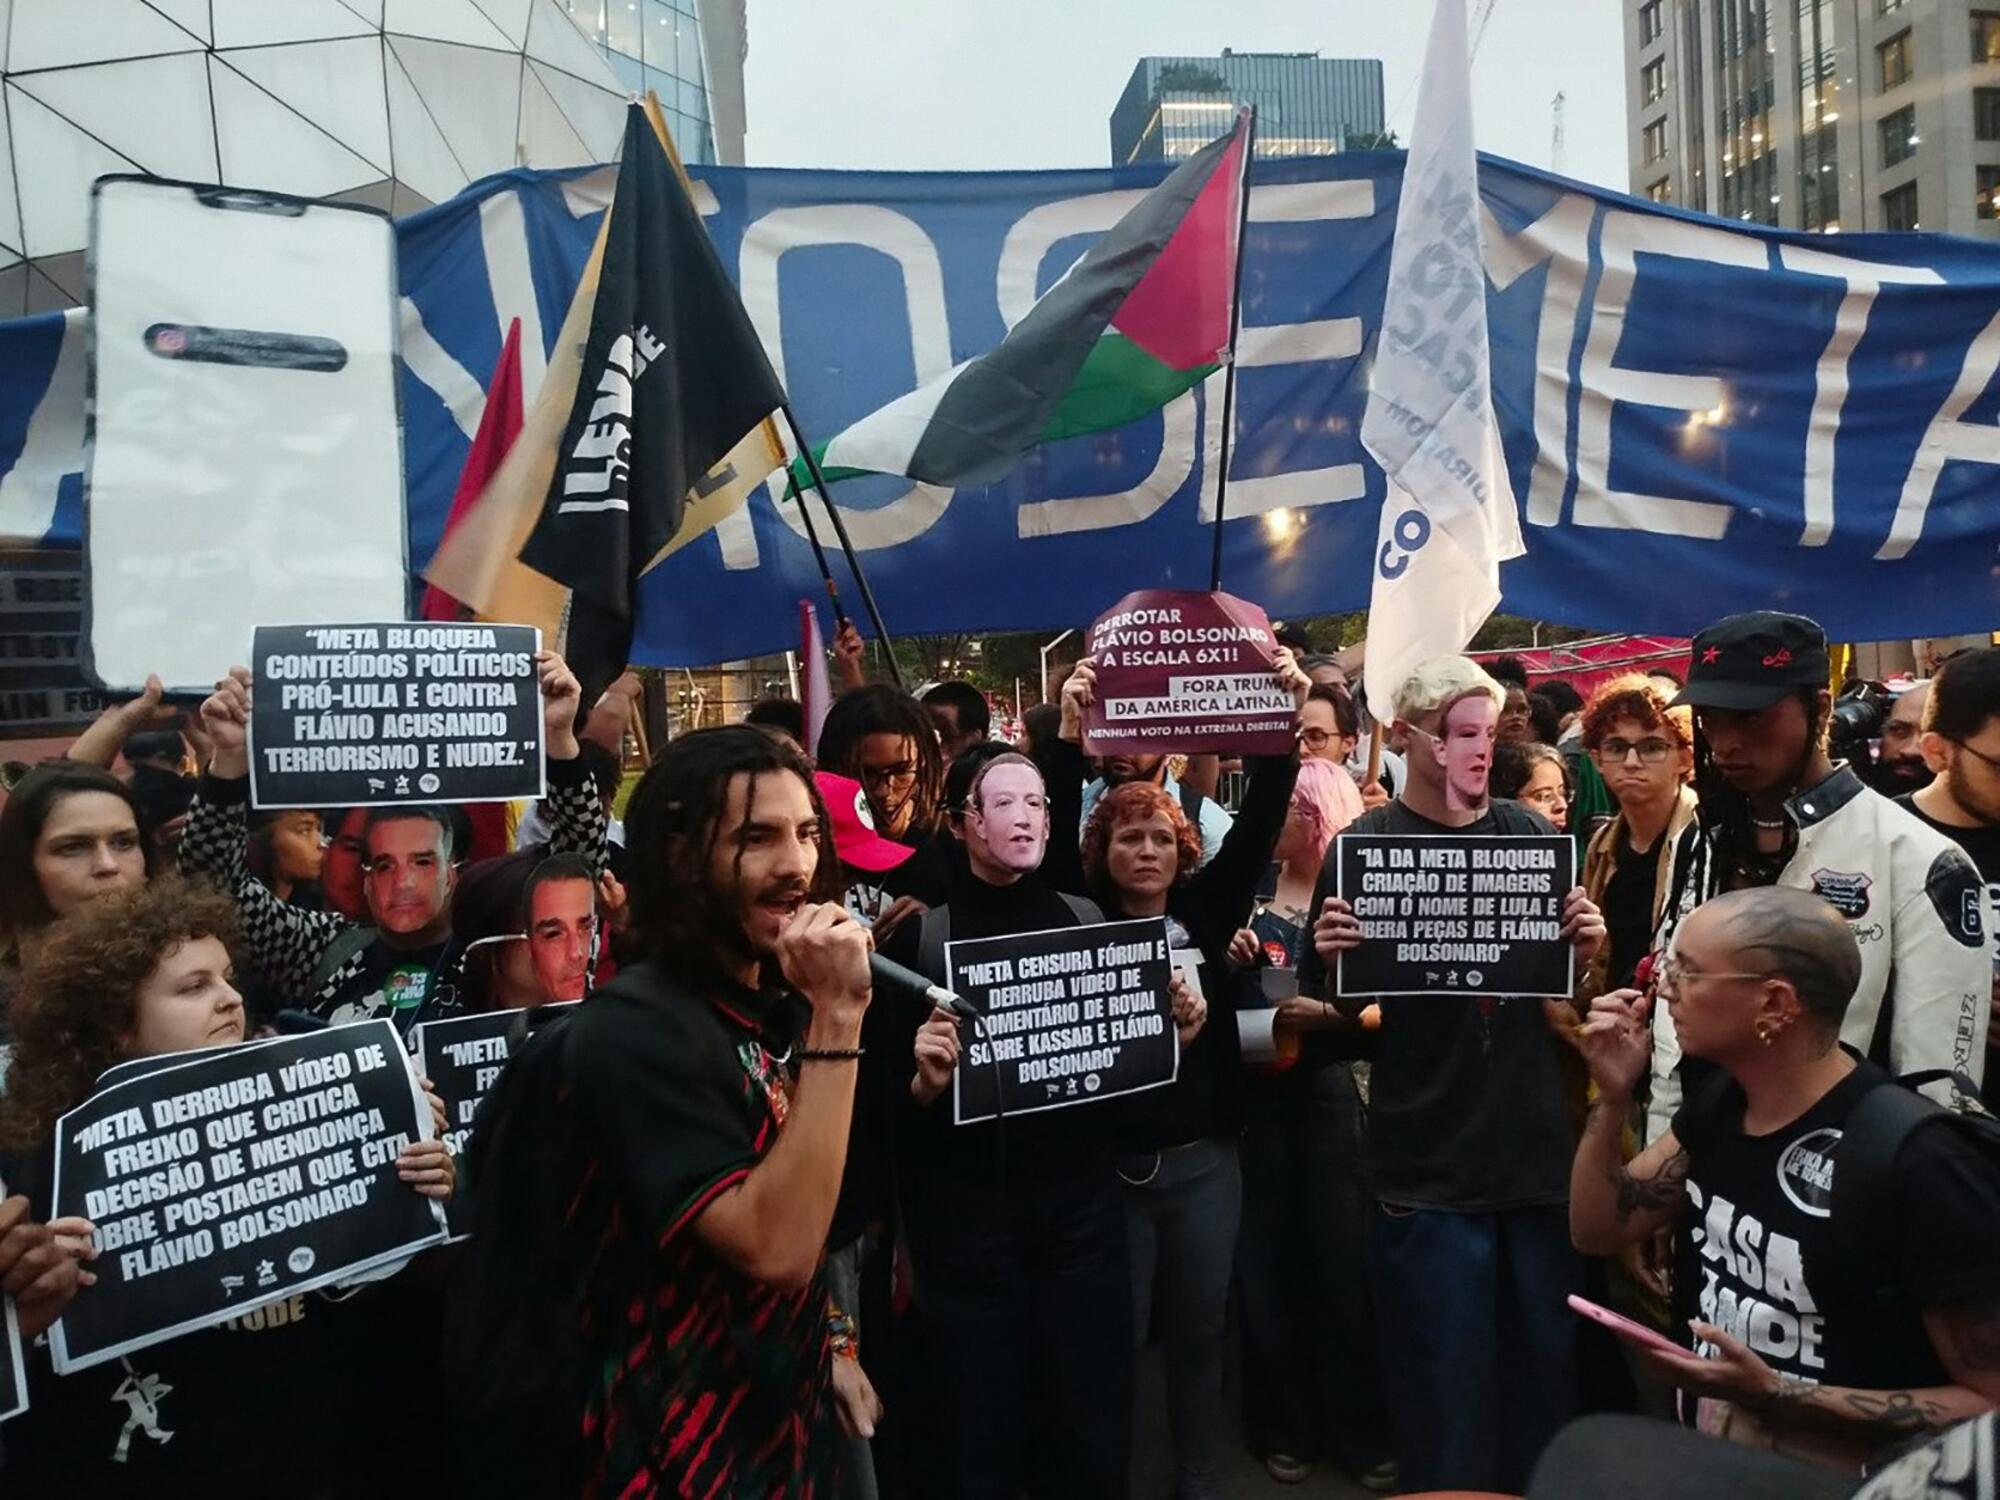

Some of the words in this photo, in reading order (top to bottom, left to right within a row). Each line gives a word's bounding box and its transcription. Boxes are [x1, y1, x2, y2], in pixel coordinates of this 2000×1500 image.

[1094, 609, 1182, 637] DERROTAR
[387, 629, 496, 651] BLOQUEIA
[1092, 630, 1154, 652] FLÁVIO
[1160, 627, 1269, 644] BOLSONARO
[266, 651, 408, 679] CONTEÚDOS
[415, 650, 531, 677] POLÍTICOS
[1103, 653, 1116, 667] A
[1122, 650, 1190, 666] ESCALA
[1196, 648, 1239, 663] 6X1!
[282, 680, 399, 709] PRÓ-LULA
[406, 684, 419, 707] E
[426, 683, 517, 707] CONTRA
[1182, 678, 1228, 694] FORA
[1233, 676, 1285, 692] TRUM
[1115, 702, 1139, 715] DA
[1144, 696, 1221, 714] AMÉRICA
[1226, 695, 1290, 710] LATINA!
[294, 711, 374, 740] FLÁVIO
[382, 712, 507, 738] ACUSANDO
[1088, 727, 1138, 739] NENHUM
[1141, 726, 1172, 737] VOTO
[1174, 725, 1191, 735] NA
[1194, 723, 1244, 734] EXTREMA
[1246, 721, 1290, 732] DIREITA!
[264, 744, 420, 772] TERRORISMO
[427, 744, 440, 768] E
[1389, 849, 1413, 868] DA
[1420, 849, 1467, 869] META
[1472, 850, 1556, 869] BLOQUEIA
[1362, 871, 1440, 897] CRIAÇÃO
[1445, 874, 1467, 893] DE
[1472, 874, 1551, 893] IMAGENS
[1354, 898, 1394, 916] COM
[1400, 897, 1412, 916] O
[1418, 898, 1467, 916] NOME
[1472, 898, 1495, 916] DE
[1500, 898, 1542, 916] LULA
[1547, 898, 1558, 916] E
[1358, 920, 1408, 939] IBERA
[1413, 921, 1467, 943] PEÇAS
[1473, 921, 1495, 939] DE
[1500, 917, 1560, 941] FLÁVIO
[1018, 950, 1093, 980] CENSURA
[1097, 941, 1152, 968] FÓRUM
[1156, 939, 1166, 960] E
[989, 978, 1066, 1010] DERRUBA
[1070, 971, 1117, 997] VÍDEO
[1121, 968, 1142, 988] DE
[1084, 999, 1104, 1020] DE
[1108, 990, 1155, 1016] ROVAI
[969, 1039, 1025, 1066] SOBRE
[1029, 1025, 1094, 1055] KASSAB
[1098, 1023, 1107, 1043] E
[1111, 1014, 1164, 1042] FLÁVIO
[151, 1071, 275, 1128] DERRUBA
[280, 1052, 351, 1090] VÍDEO
[355, 1043, 387, 1071] DE
[104, 1127, 199, 1179] FREIXO
[206, 1108, 258, 1144] QUE
[262, 1082, 361, 1128] CRITICA
[85, 1161, 205, 1219] DECISÃO
[212, 1150, 244, 1183] DE
[250, 1108, 385, 1170] MENDONÇA
[92, 1210, 158, 1255] OBRE
[165, 1165, 303, 1233] POSTAGEM
[309, 1151, 357, 1186] QUE
[120, 1230, 215, 1282] FLÁVIO
